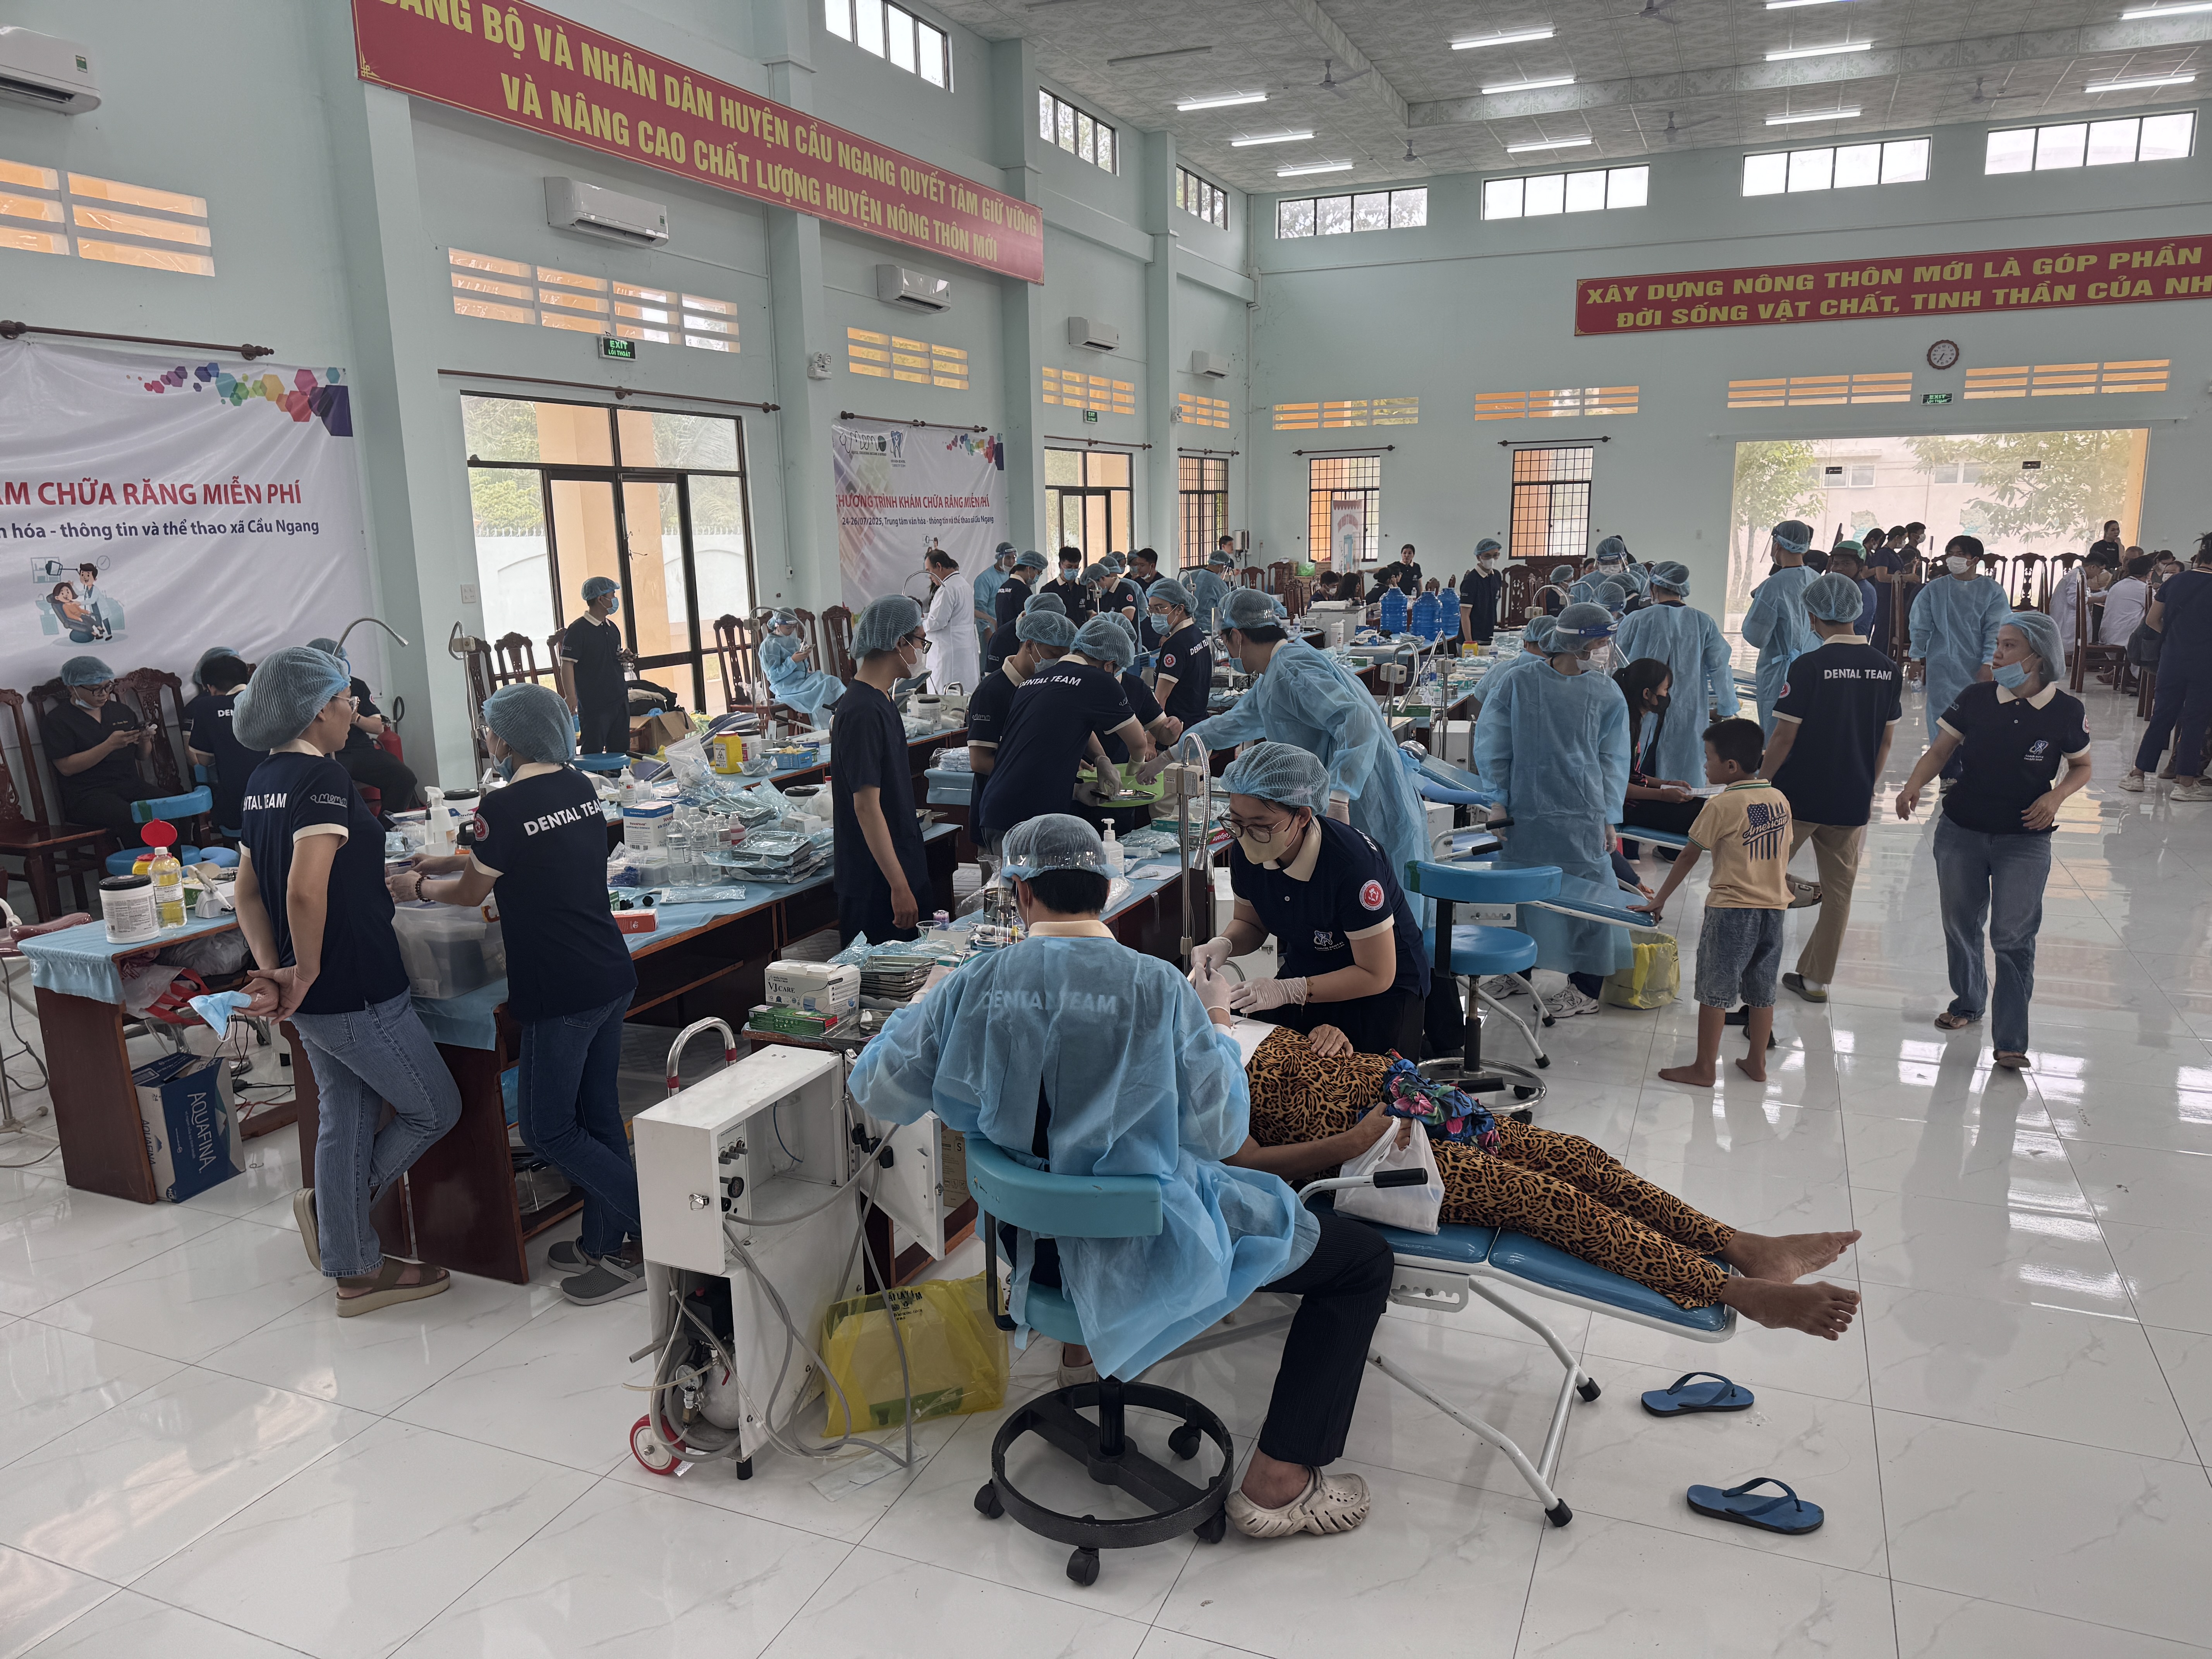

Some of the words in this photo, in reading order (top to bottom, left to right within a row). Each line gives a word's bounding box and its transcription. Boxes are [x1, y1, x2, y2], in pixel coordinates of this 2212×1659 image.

[380, 0, 472, 34] NG
[482, 3, 525, 59] BỘ
[534, 23, 574, 71] VÀ
[581, 42, 657, 101] NHÂN
[664, 74, 713, 121] DÂN
[720, 96, 789, 148] HUYỆN
[795, 122, 832, 162] CẦU
[838, 141, 895, 187] NGANG
[900, 166, 945, 204] QUYẾT
[950, 184, 977, 216] TÂM
[982, 198, 1003, 224] GIỮ
[1006, 206, 1036, 237] VỮNG
[501, 73, 543, 119] VÀ
[551, 90, 629, 147] NÂNG
[638, 120, 685, 163] CAO
[694, 140, 749, 183] CHẤT
[756, 159, 820, 206] LƯỢNG
[826, 183, 881, 227] HUYỆN
[887, 203, 929, 240] NÔNG
[933, 220, 969, 252] THÔN
[973, 233, 997, 262] MỚI
[1587, 285, 1638, 304] XÂY
[1648, 280, 1723, 302] DỰNG
[1733, 274, 1814, 294] NÔNG
[1824, 266, 1903, 288] THÔN
[1913, 261, 1973, 282] MỚI
[1984, 257, 2021, 278] LÀ
[2033, 253, 2097, 275] GÓP
[2109, 243, 2202, 269] PHẦN
[1617, 308, 1662, 327] ĐỜI
[1671, 302, 1748, 324] SỐNG
[1758, 299, 1810, 321] VẬT
[1820, 291, 1899, 315] CHẤT,
[1911, 290, 1981, 309] TINH
[1993, 281, 2076, 304] THẦN
[2088, 276, 2153, 299] CỦA
[610, 340, 627, 349] EXIT
[0, 482, 31, 505] M
[38, 477, 117, 505] CHỮA
[124, 479, 197, 505] RĂNG
[203, 476, 261, 505] MIỄN
[268, 480, 302, 504] PHÍ
[874, 493, 897, 508] TRÌNH
[899, 494, 921, 508] KHÁM
[923, 494, 943, 508] CHỮA
[945, 495, 963, 508] RĂNG
[12, 522, 46, 538] hóa
[60, 522, 112, 541] thông
[116, 522, 138, 536] tin
[142, 522, 159, 536] và
[163, 519, 188, 535] thể
[191, 520, 227, 534] thao
[230, 520, 244, 534] xã
[247, 517, 273, 534] Cầu
[276, 519, 319, 535] Ngang
[884, 517, 898, 527] Trung
[1018, 677, 1049, 689] DENTAL
[1050, 675, 1082, 686] TEAM
[1824, 669, 1861, 680] DENTAL
[1865, 669, 1892, 680] TEAM
[523, 807, 581, 836] DENTAL
[1743, 815, 1788, 838] American
[1212, 832, 1231, 842] Colgate
[187, 1092, 216, 1171] AQUAFINA
[957, 1143, 962, 1151] S
